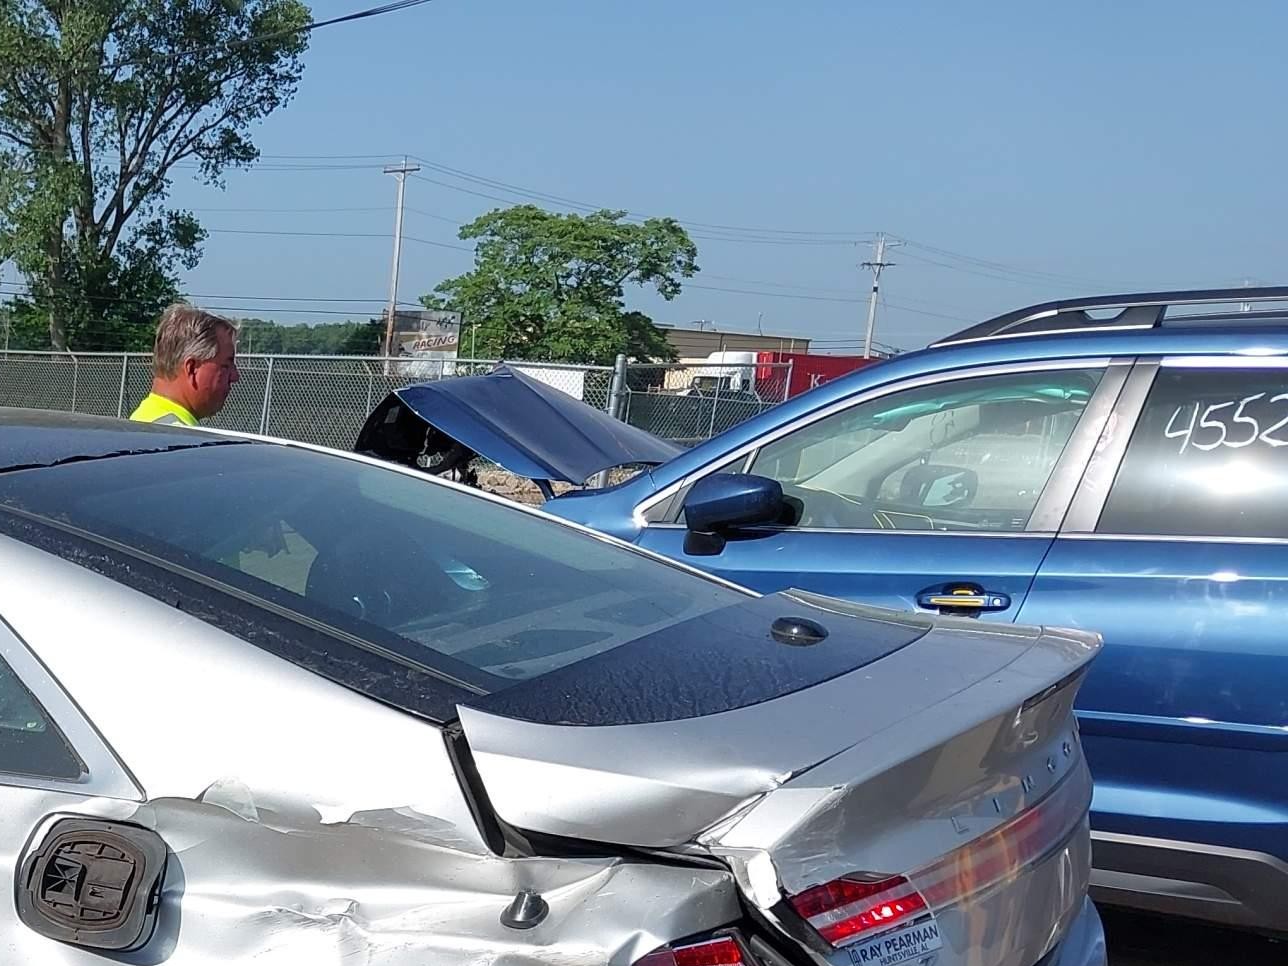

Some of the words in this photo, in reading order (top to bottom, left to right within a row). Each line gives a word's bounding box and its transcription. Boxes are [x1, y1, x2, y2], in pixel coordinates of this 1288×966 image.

[413, 335, 455, 349] RACING
[1165, 392, 1288, 454] 4552
[860, 943, 883, 963] RAY
[884, 925, 938, 953] PEARMAN
